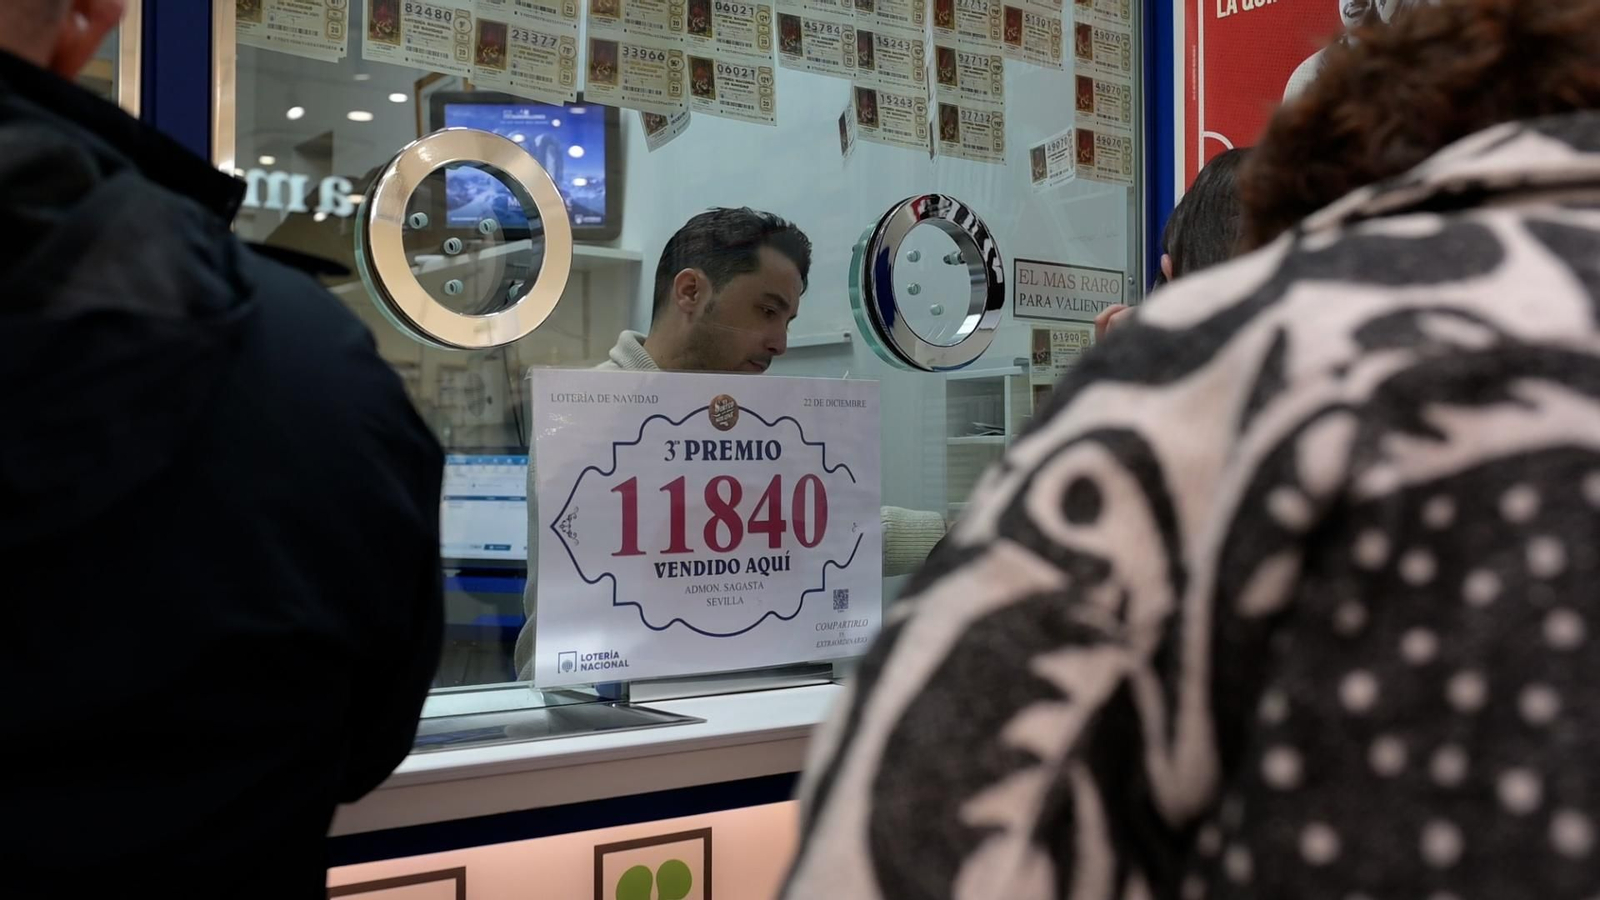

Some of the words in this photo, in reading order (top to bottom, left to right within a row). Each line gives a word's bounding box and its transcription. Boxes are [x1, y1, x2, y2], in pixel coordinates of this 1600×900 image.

[405, 2, 451, 21] 82480
[715, 1, 754, 16] 06021
[804, 21, 840, 34] 45784
[512, 29, 557, 46] 23377
[876, 36, 910, 50] 15243
[623, 46, 665, 61] 33966
[958, 53, 989, 67] 97712
[717, 63, 755, 81] 06021
[880, 94, 913, 108] 15243
[961, 110, 991, 123] 97712
[1018, 269, 1039, 286] EL
[1043, 271, 1076, 289] MAS
[1081, 276, 1120, 295] RARO
[1020, 293, 1052, 308] PARA
[550, 391, 595, 403] LOTERÍA
[597, 394, 611, 403] DE
[613, 394, 659, 405] NAVIDAD
[803, 398, 812, 407] 22
[813, 398, 824, 408] DE
[825, 399, 867, 408] DICIEMBRE
[684, 439, 782, 461] PREMIO
[611, 473, 828, 557] 11840
[654, 558, 741, 579] VENDIDO
[745, 550, 791, 576] AQUÍ
[685, 584, 722, 595] ADMON.
[724, 581, 765, 592] SAGASTA
[706, 596, 744, 607] SEVILLA
[815, 619, 869, 632] COMPARTIRLO
[581, 649, 620, 662] LOTERÍA
[581, 659, 630, 671] NACIONAL
